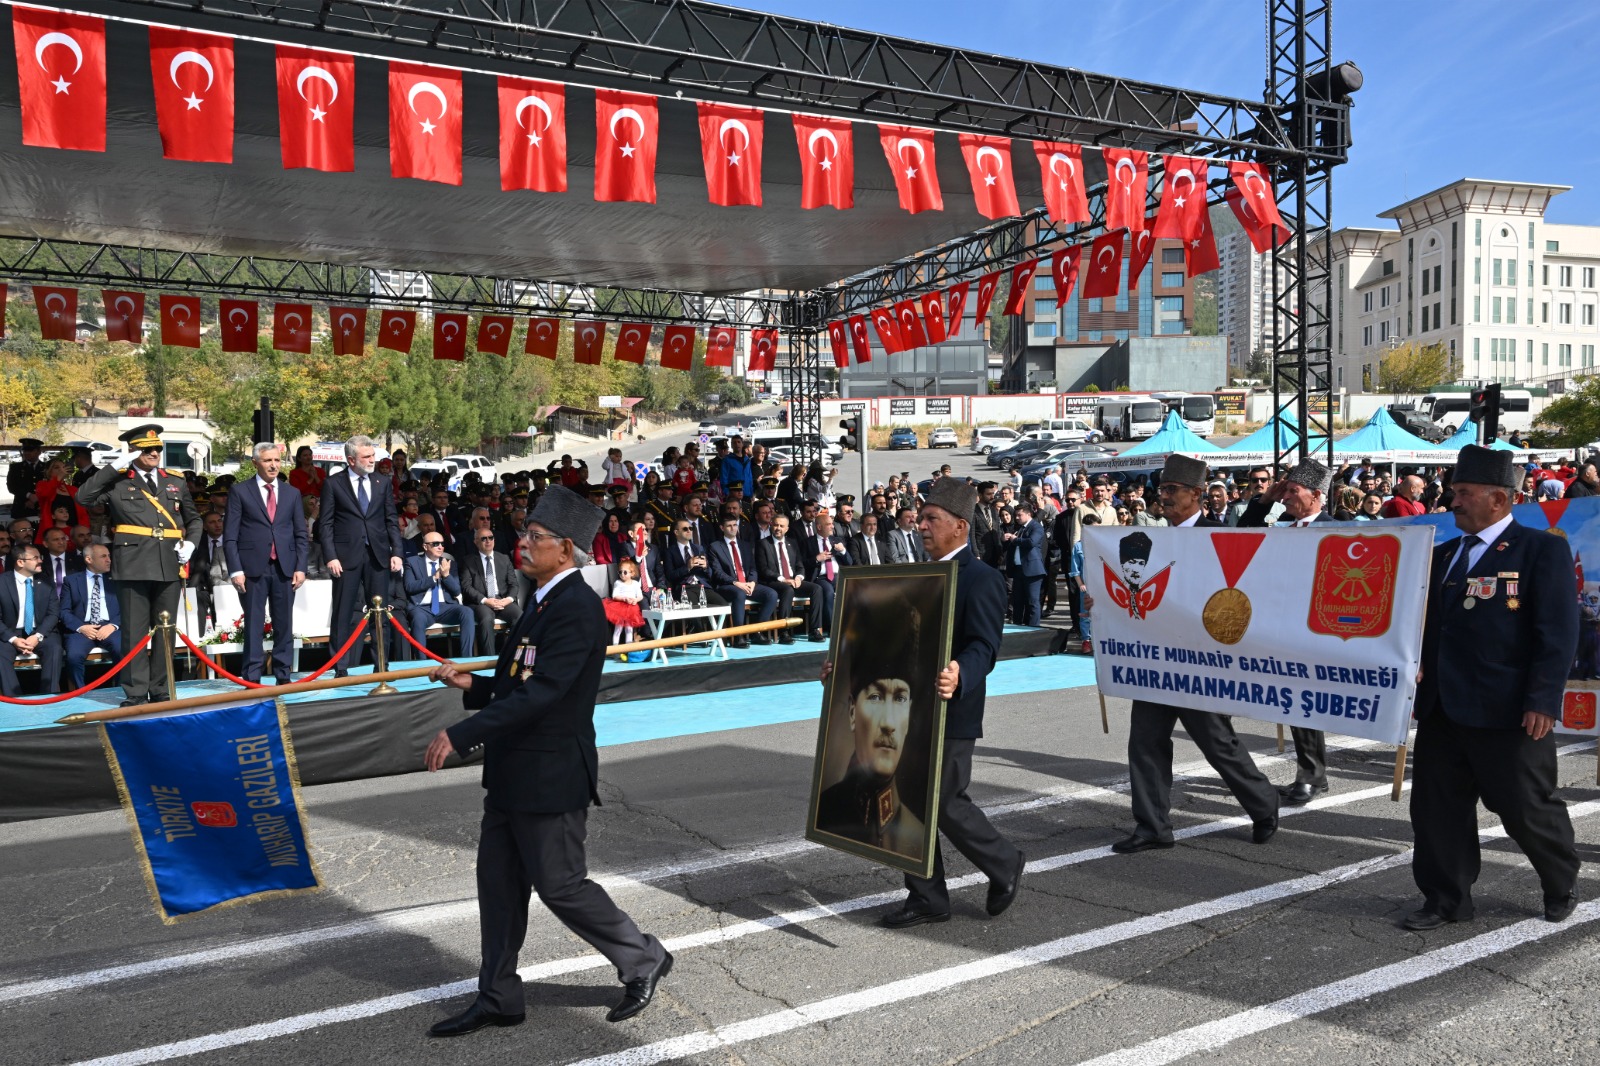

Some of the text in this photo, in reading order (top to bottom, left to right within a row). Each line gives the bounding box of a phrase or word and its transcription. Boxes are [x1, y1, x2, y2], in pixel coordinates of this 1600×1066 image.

[1100, 639, 1398, 689] TÜRKİYE MUHARİP GAZİLER DERNEĞİ
[1112, 666, 1381, 722] KAHRAMANMARAŞ ŞUBESİ
[146, 784, 197, 843] TÜRKİYE
[227, 733, 299, 867] MUHARİP GAZİLERİ
